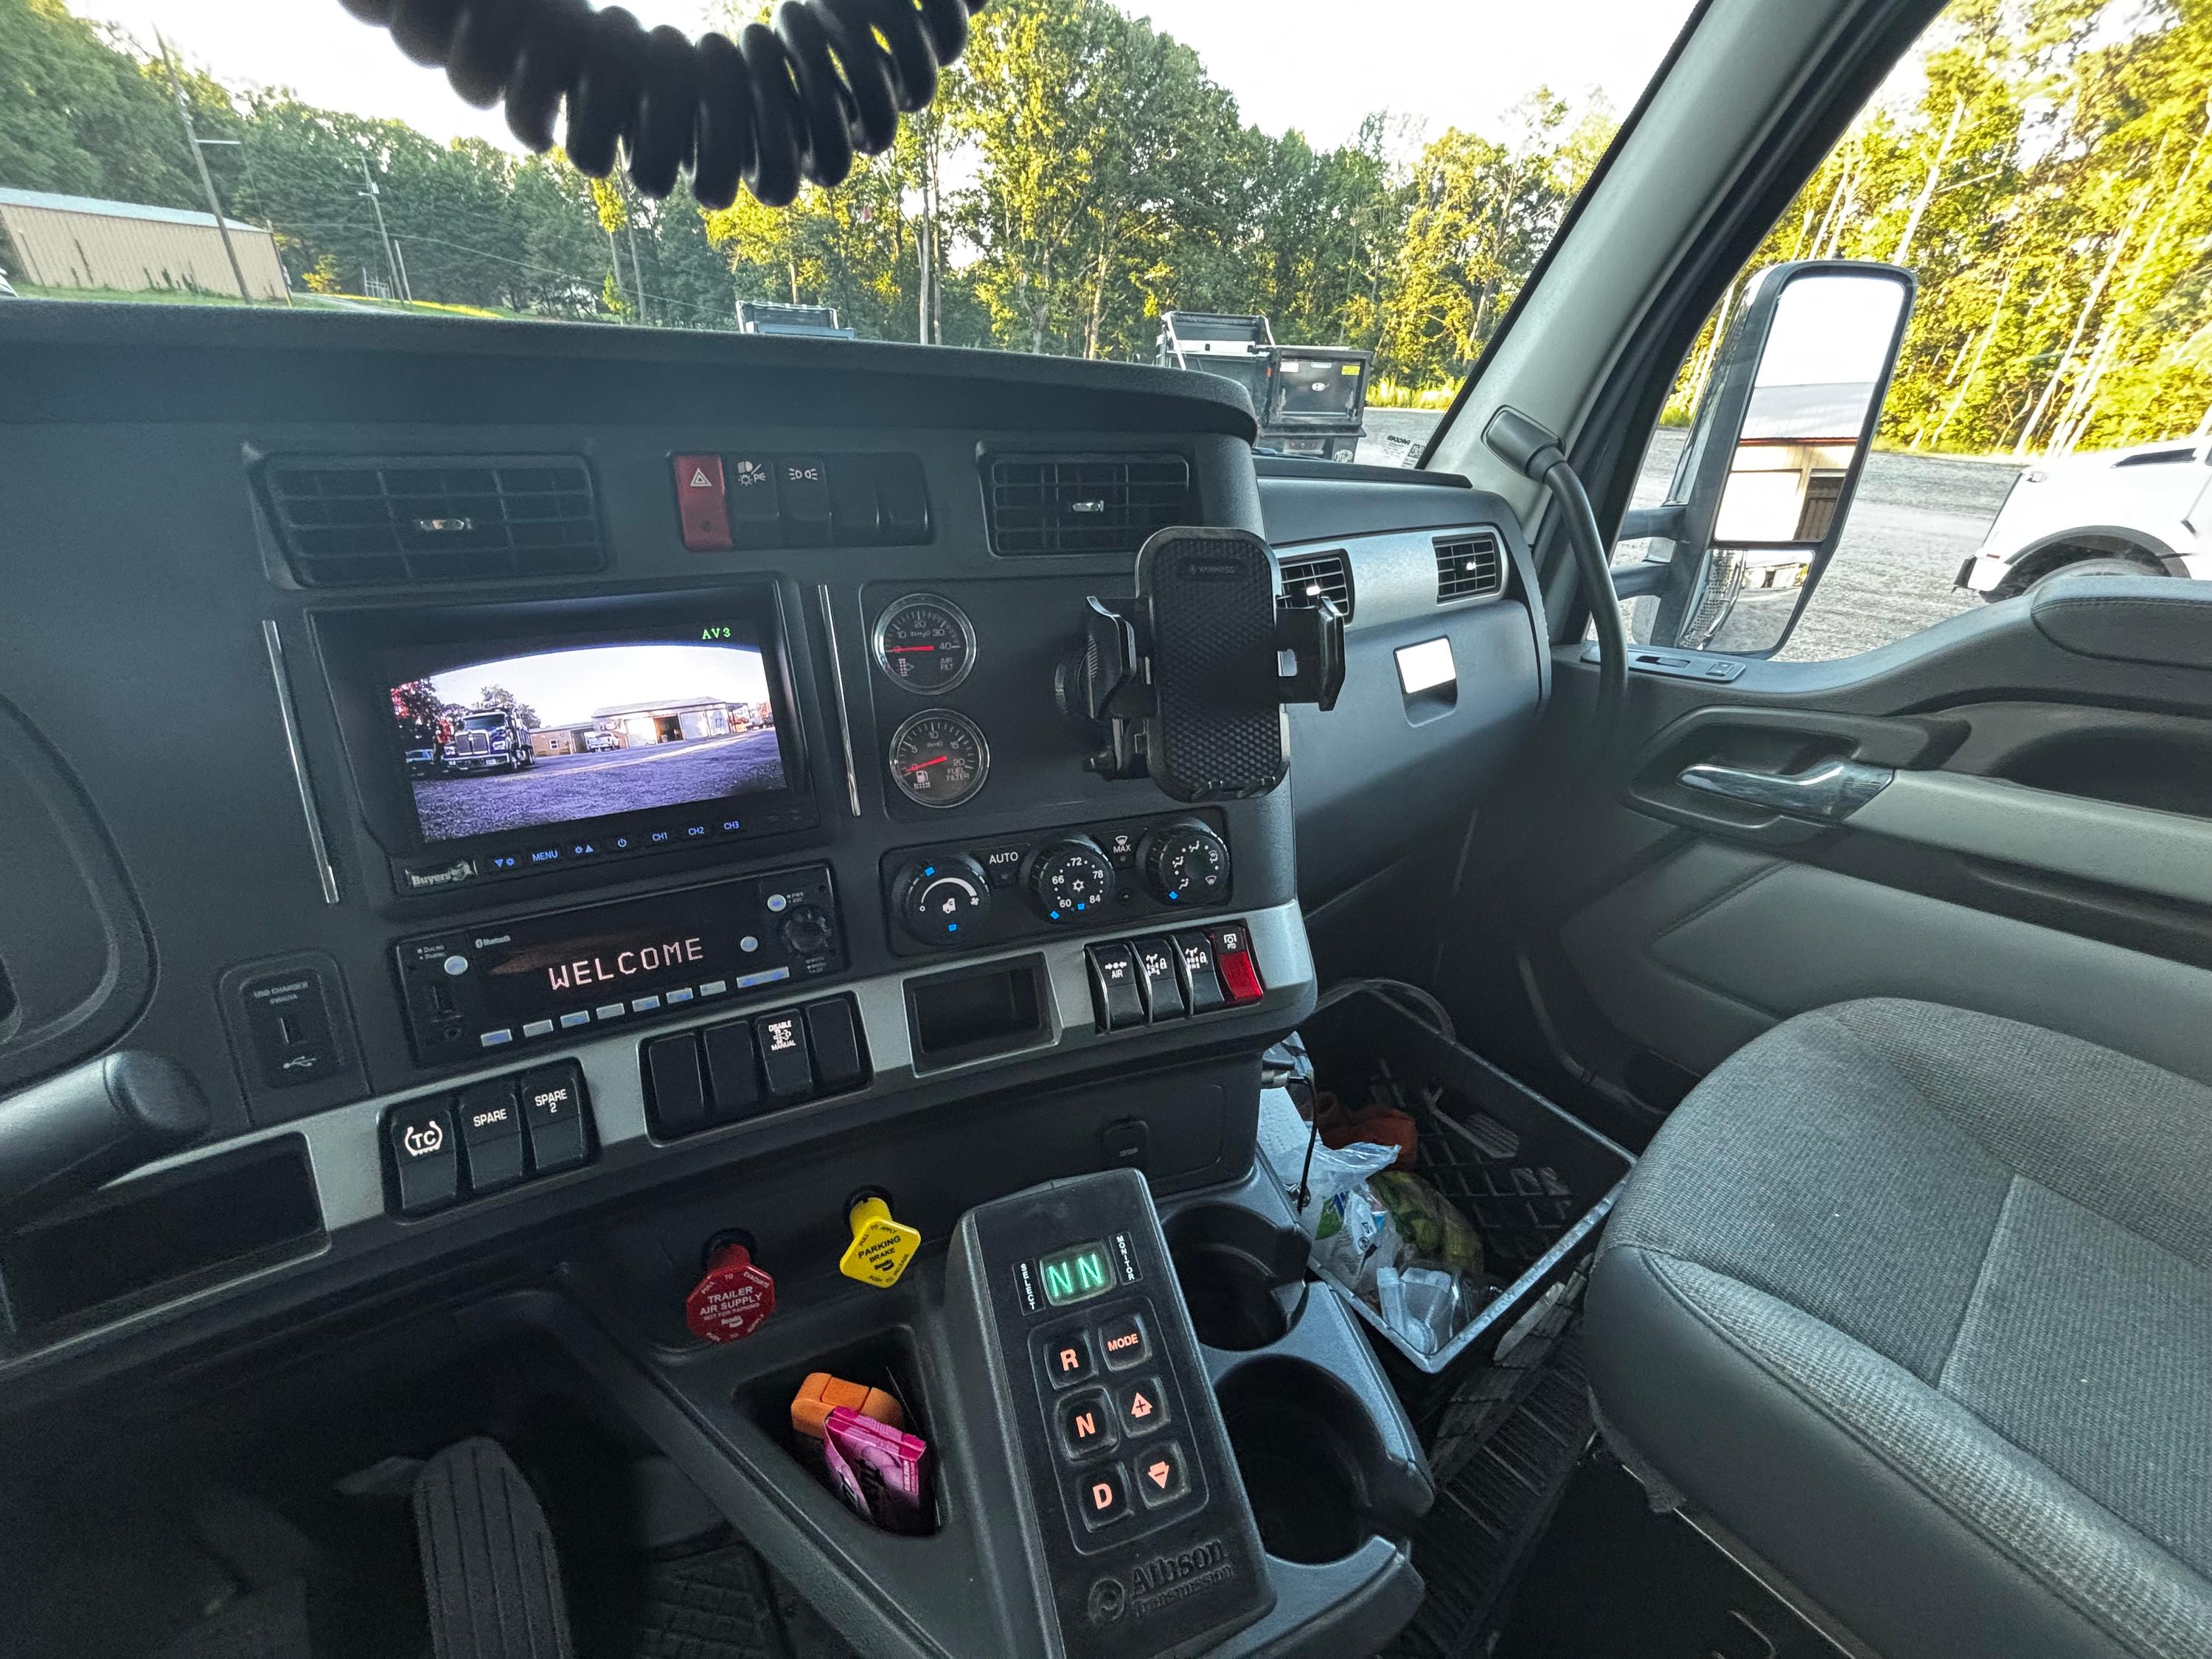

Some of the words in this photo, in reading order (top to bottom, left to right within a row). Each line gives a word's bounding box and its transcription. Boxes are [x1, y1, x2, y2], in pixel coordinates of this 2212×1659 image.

[914, 620, 926, 628] 20
[933, 628, 945, 636] 30
[911, 745, 918, 753] 5
[950, 740, 959, 749] 15
[953, 758, 965, 767] 20
[946, 773, 970, 782] FILTER
[688, 826, 705, 835] CH2
[723, 821, 740, 830] CH3
[652, 832, 667, 841] CH1
[1113, 844, 1131, 853] MAX
[532, 849, 558, 862] MENU
[989, 852, 1019, 864] AUTO
[1071, 857, 1082, 866] 72
[411, 872, 451, 887] Buyers
[1051, 875, 1064, 885] 66
[1093, 870, 1103, 879] 78
[1060, 899, 1071, 908] 60
[1089, 894, 1101, 903] 84
[549, 937, 703, 990] WELCOME
[1112, 969, 1123, 978] AIR
[271, 981, 308, 995] CHARGER
[768, 1020, 792, 1032] DISABLE
[771, 1040, 796, 1051] MANUAL
[535, 1088, 568, 1107] SPARE
[549, 1102, 557, 1113] 2
[473, 1108, 507, 1127] SPARE
[411, 1130, 436, 1148] TC
[858, 1235, 901, 1259] PARKING
[869, 1248, 896, 1262] BRAKE
[1116, 1235, 1135, 1281] MONITOR
[743, 1271, 771, 1289] EVACUATE
[1020, 1263, 1034, 1310] SELECT
[708, 1286, 753, 1304] TRAILER
[700, 1304, 717, 1316] AIR
[721, 1292, 762, 1310] SUPPLY
[703, 1313, 717, 1321] NOT
[1107, 1333, 1138, 1352] MODE
[1060, 1349, 1079, 1371] R
[1076, 1413, 1096, 1438] N
[1092, 1483, 1113, 1510] D
[1132, 1540, 1224, 1598] Allison
